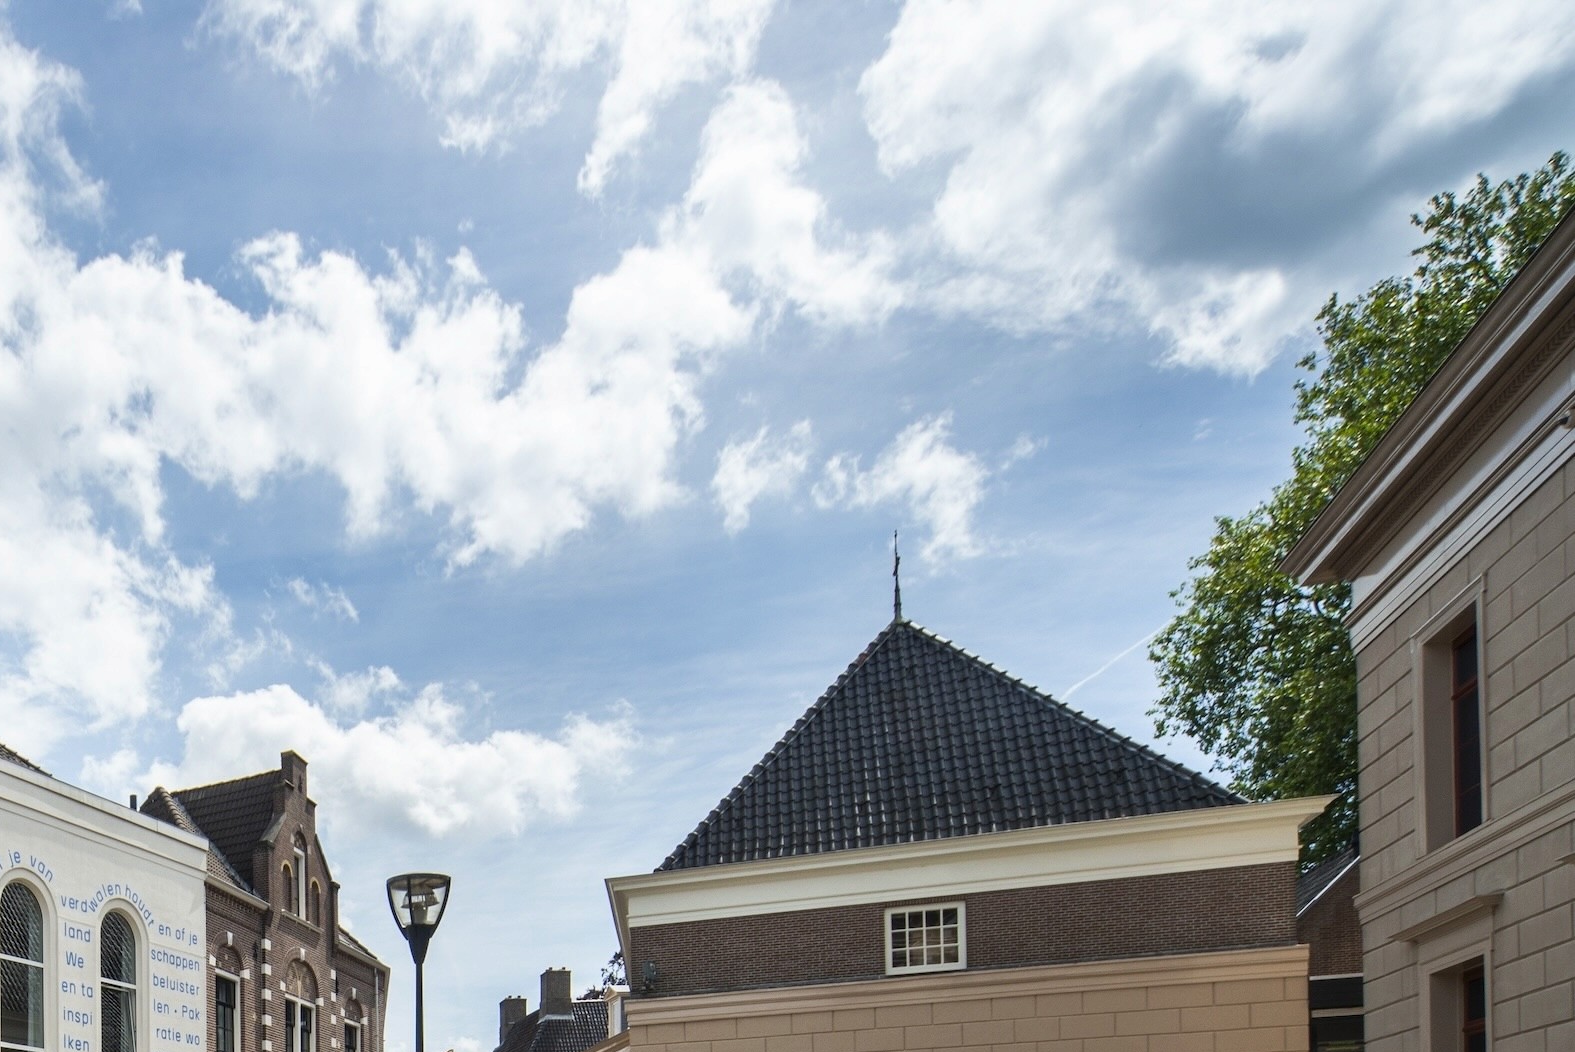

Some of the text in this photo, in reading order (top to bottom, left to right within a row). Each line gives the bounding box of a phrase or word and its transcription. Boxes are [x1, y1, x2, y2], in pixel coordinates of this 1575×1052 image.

[9, 851, 21, 867] je
[30, 856, 53, 883] van
[61, 884, 121, 913] verdwalen
[125, 885, 154, 929] houdt
[159, 924, 171, 936] en
[175, 928, 185, 940] of
[189, 934, 197, 946] je
[65, 923, 90, 942] land
[151, 949, 199, 971] schappen
[66, 951, 84, 968] We
[153, 974, 199, 995] beluister
[62, 981, 76, 994] en
[81, 984, 93, 998] ta
[154, 999, 169, 1014] len
[182, 1005, 200, 1020] Pak
[64, 1010, 92, 1027] inspi
[156, 1028, 181, 1042] ratie
[186, 1034, 200, 1045] wo
